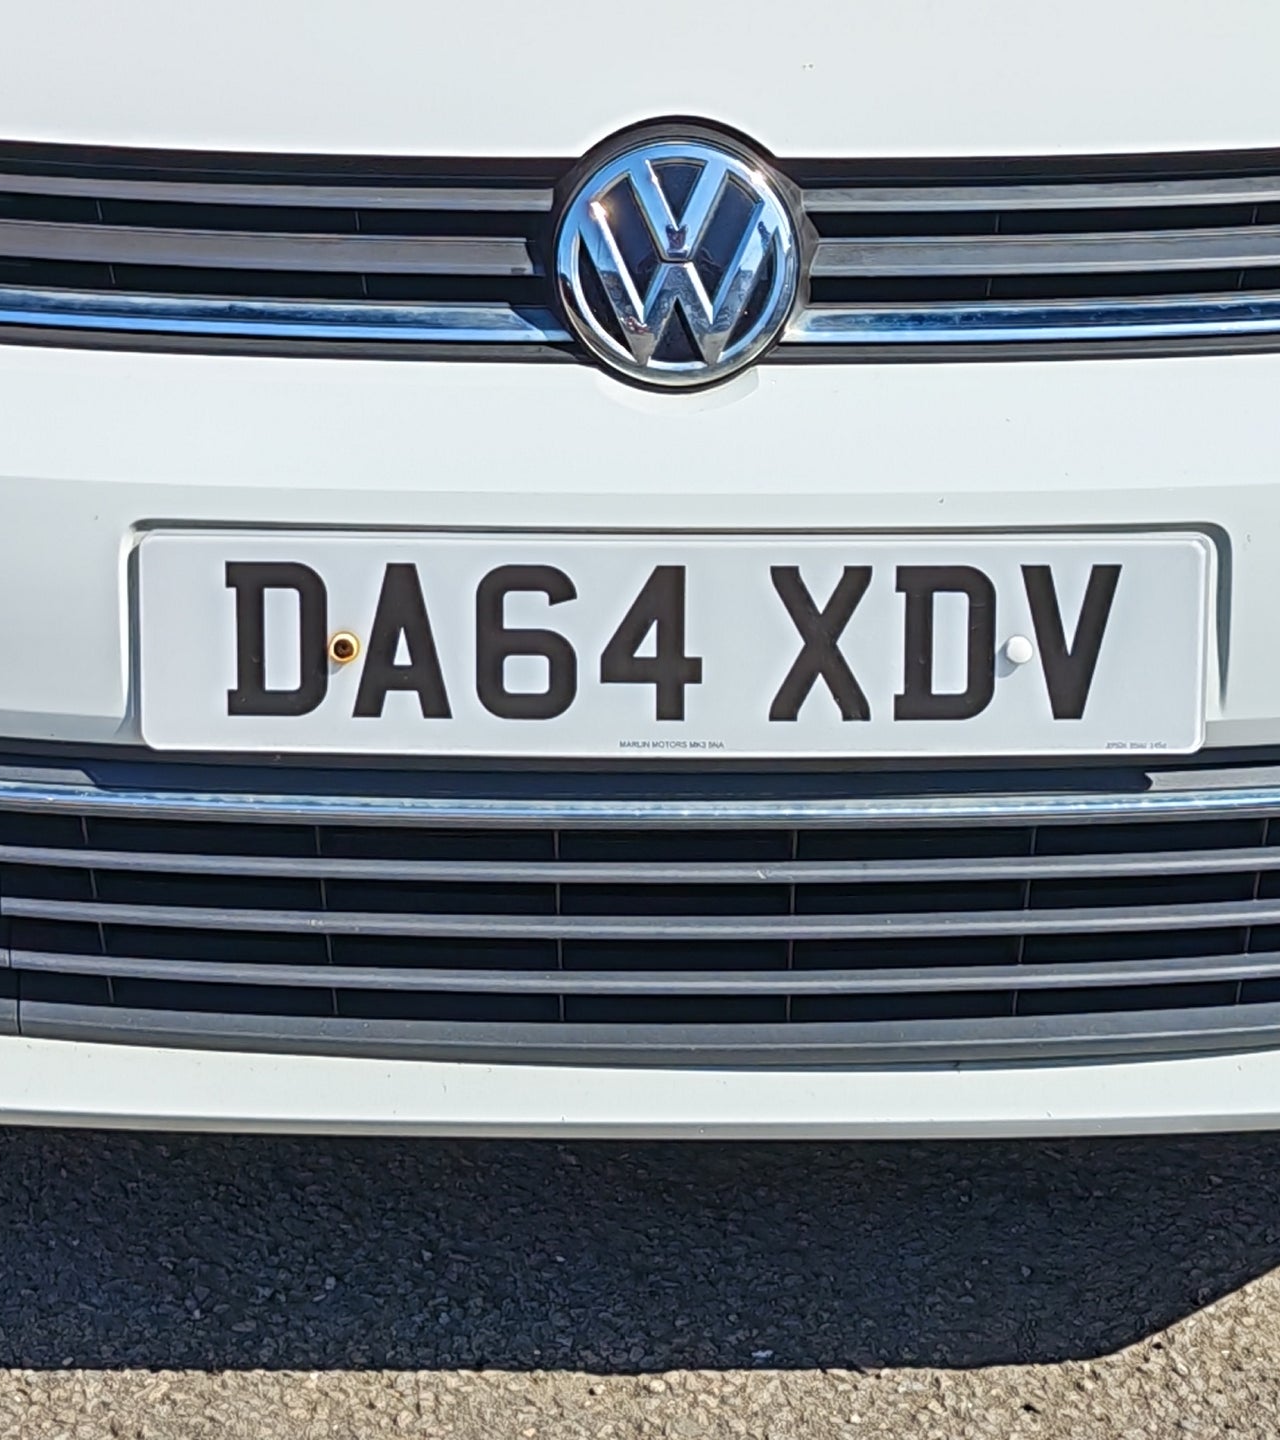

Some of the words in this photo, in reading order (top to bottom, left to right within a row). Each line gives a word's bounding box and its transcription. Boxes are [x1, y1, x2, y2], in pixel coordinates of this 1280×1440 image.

[558, 143, 799, 384] VW
[225, 561, 703, 722] DA64
[768, 565, 1123, 722] XDV
[619, 740, 650, 749] MARLIN
[651, 740, 688, 749] MOTORS
